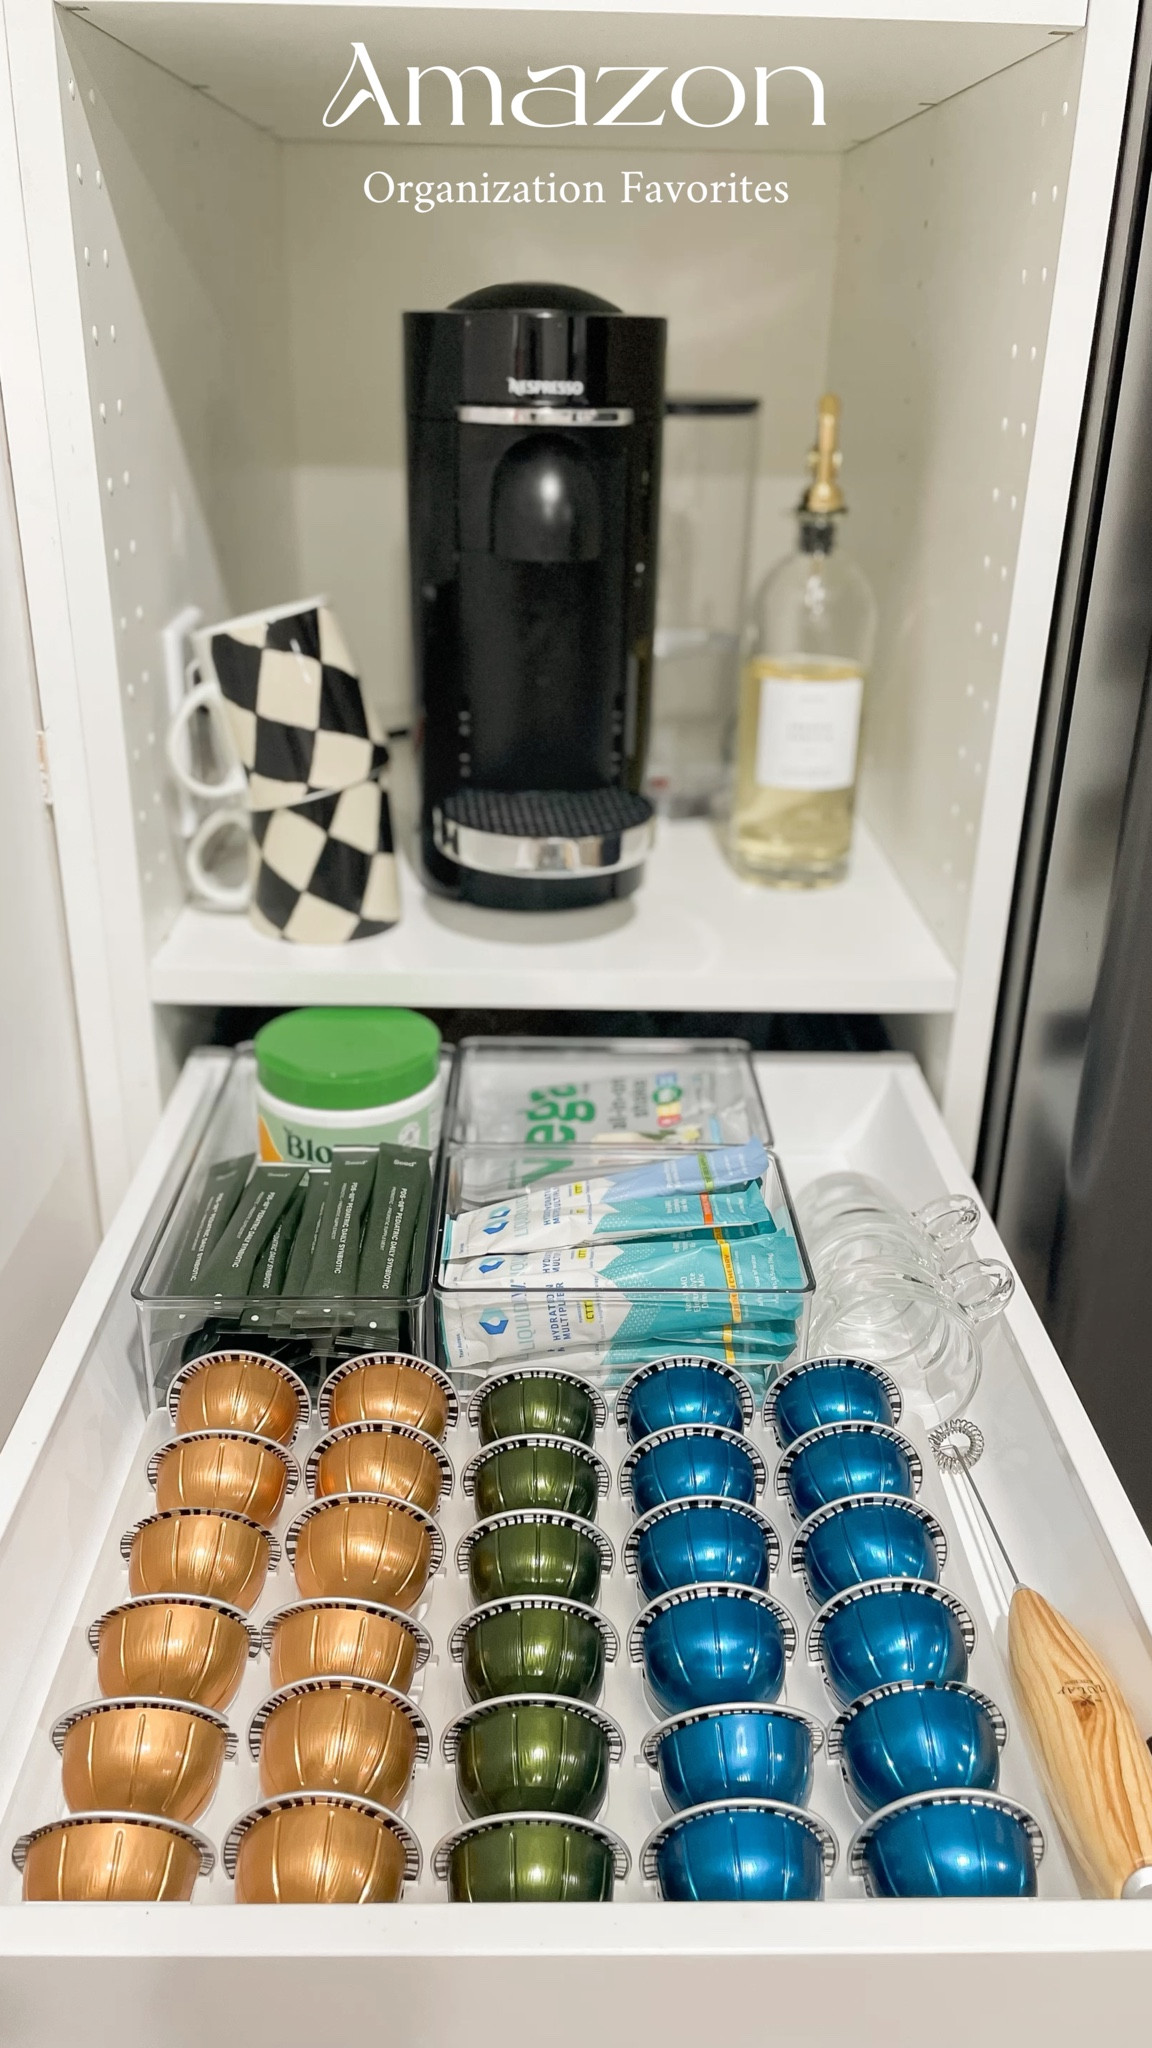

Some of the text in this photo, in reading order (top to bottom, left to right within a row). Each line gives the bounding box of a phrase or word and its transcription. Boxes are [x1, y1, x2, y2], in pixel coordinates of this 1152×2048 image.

[506, 377, 585, 397] NESPRESSO
[392, 1212, 403, 1240] PEDIATRIC
[334, 1244, 345, 1274] SYNBIOTIC
[388, 1241, 397, 1257] DAILY
[382, 1257, 394, 1289] SYNBIOTIC
[724, 1254, 735, 1283] CHERRY
